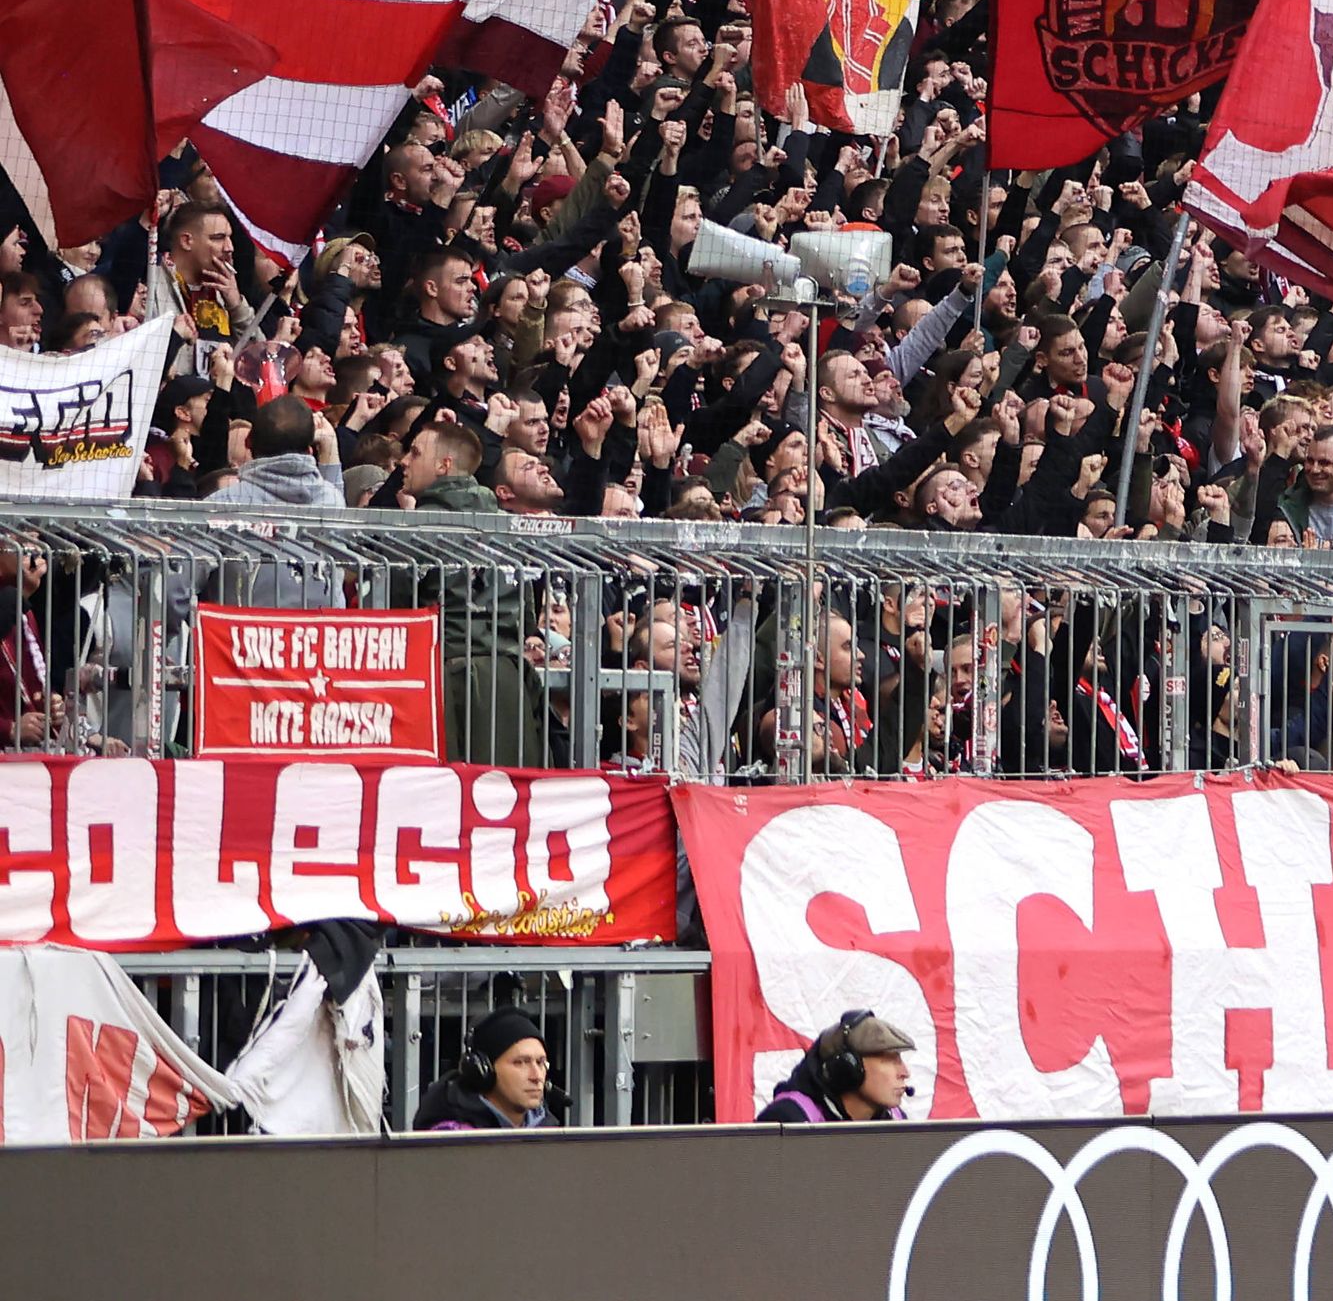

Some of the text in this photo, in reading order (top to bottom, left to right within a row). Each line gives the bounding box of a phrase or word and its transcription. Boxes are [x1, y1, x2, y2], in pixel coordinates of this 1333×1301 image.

[231, 625, 408, 671] LOVE FC BAYERN
[250, 701, 394, 746] HATE RACISM
